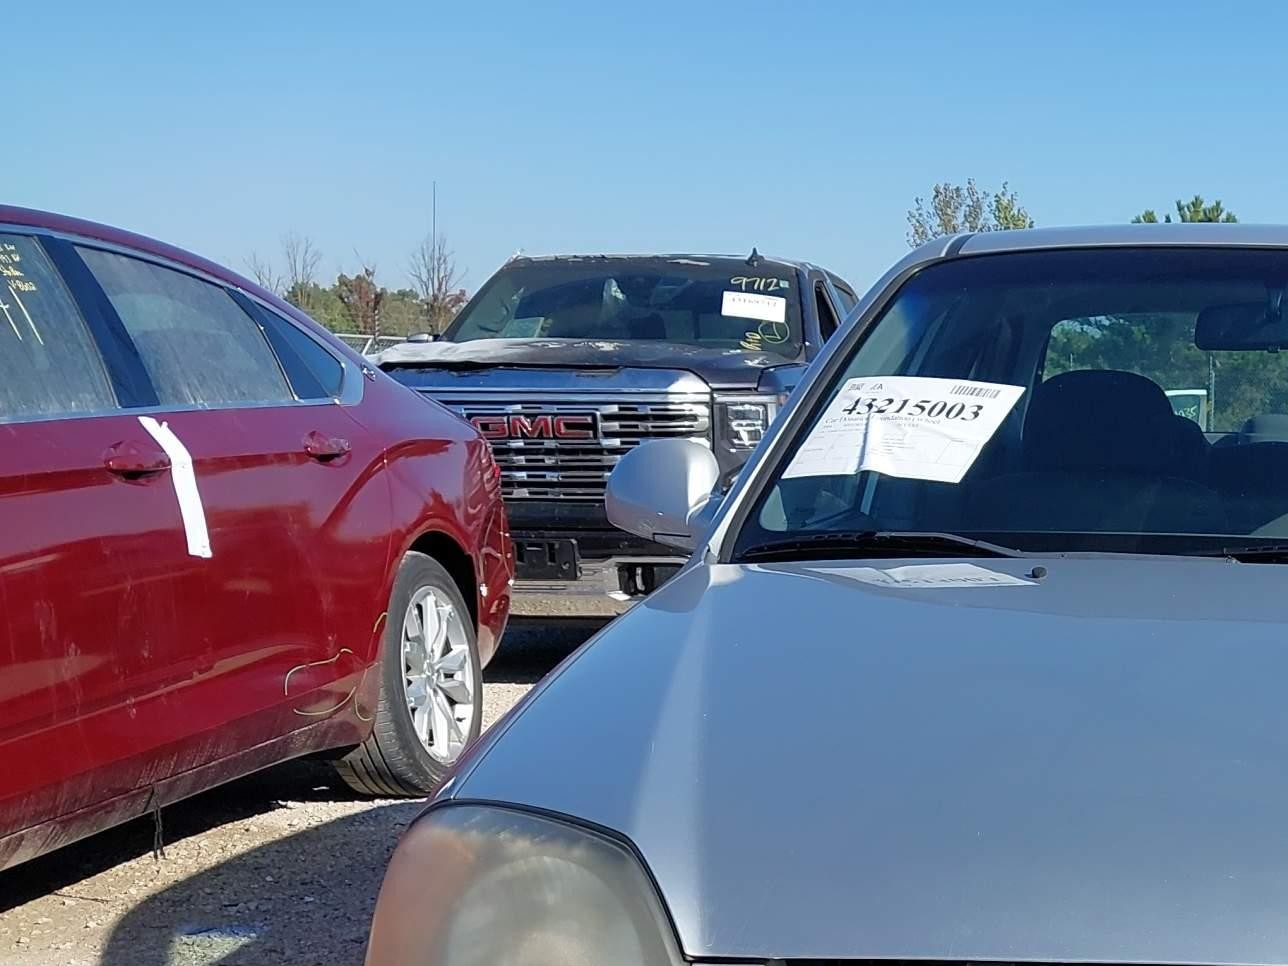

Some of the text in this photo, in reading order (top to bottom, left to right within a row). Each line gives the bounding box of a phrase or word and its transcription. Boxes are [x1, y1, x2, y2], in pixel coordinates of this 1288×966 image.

[730, 276, 780, 291] 9712
[842, 396, 984, 422] 43215003
[470, 415, 594, 438] GMC
